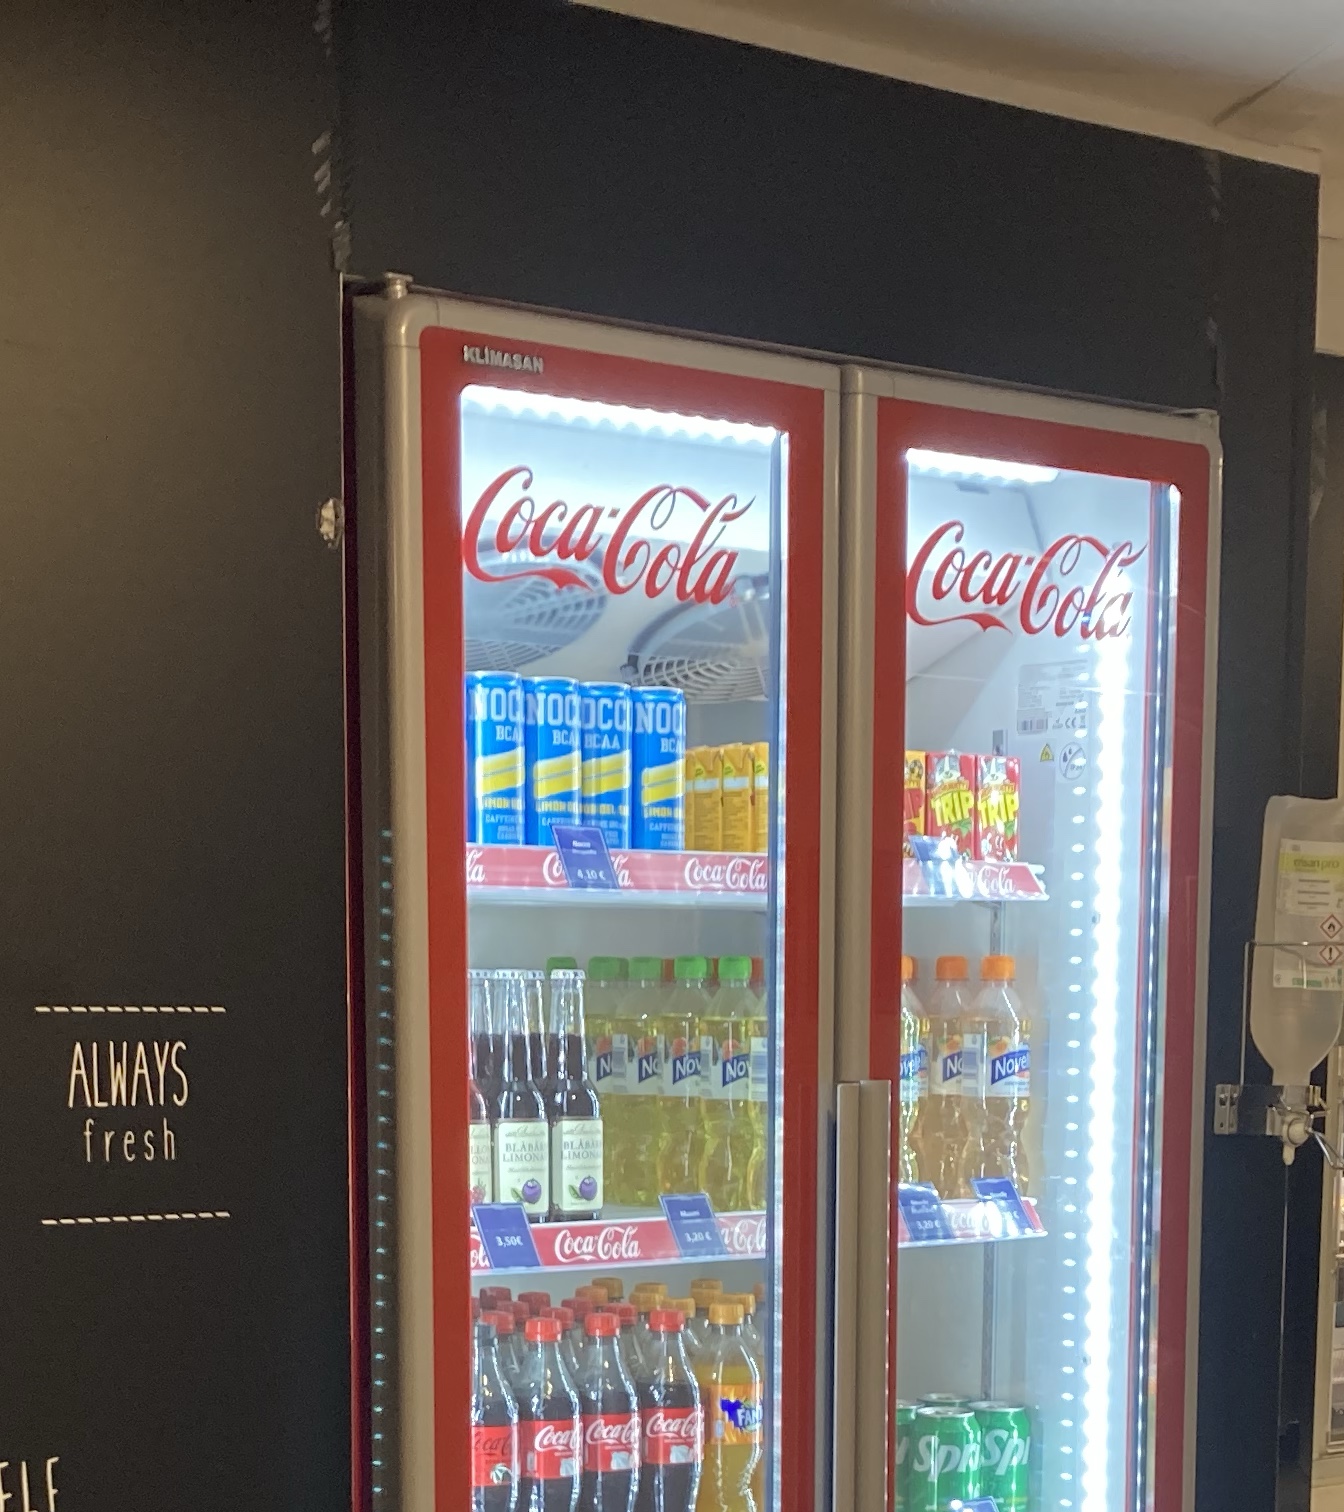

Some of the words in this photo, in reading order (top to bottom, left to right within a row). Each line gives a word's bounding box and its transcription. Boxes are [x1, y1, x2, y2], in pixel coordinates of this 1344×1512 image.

[461, 464, 757, 606] Coca-Cola
[906, 519, 1149, 641] Coca-Cola
[930, 790, 975, 827] TRIP
[977, 791, 1020, 829] TRIP
[67, 1039, 190, 1109] ALWAYS
[82, 1116, 177, 1164] fresh
[554, 1225, 641, 1264] Coca-Cola
